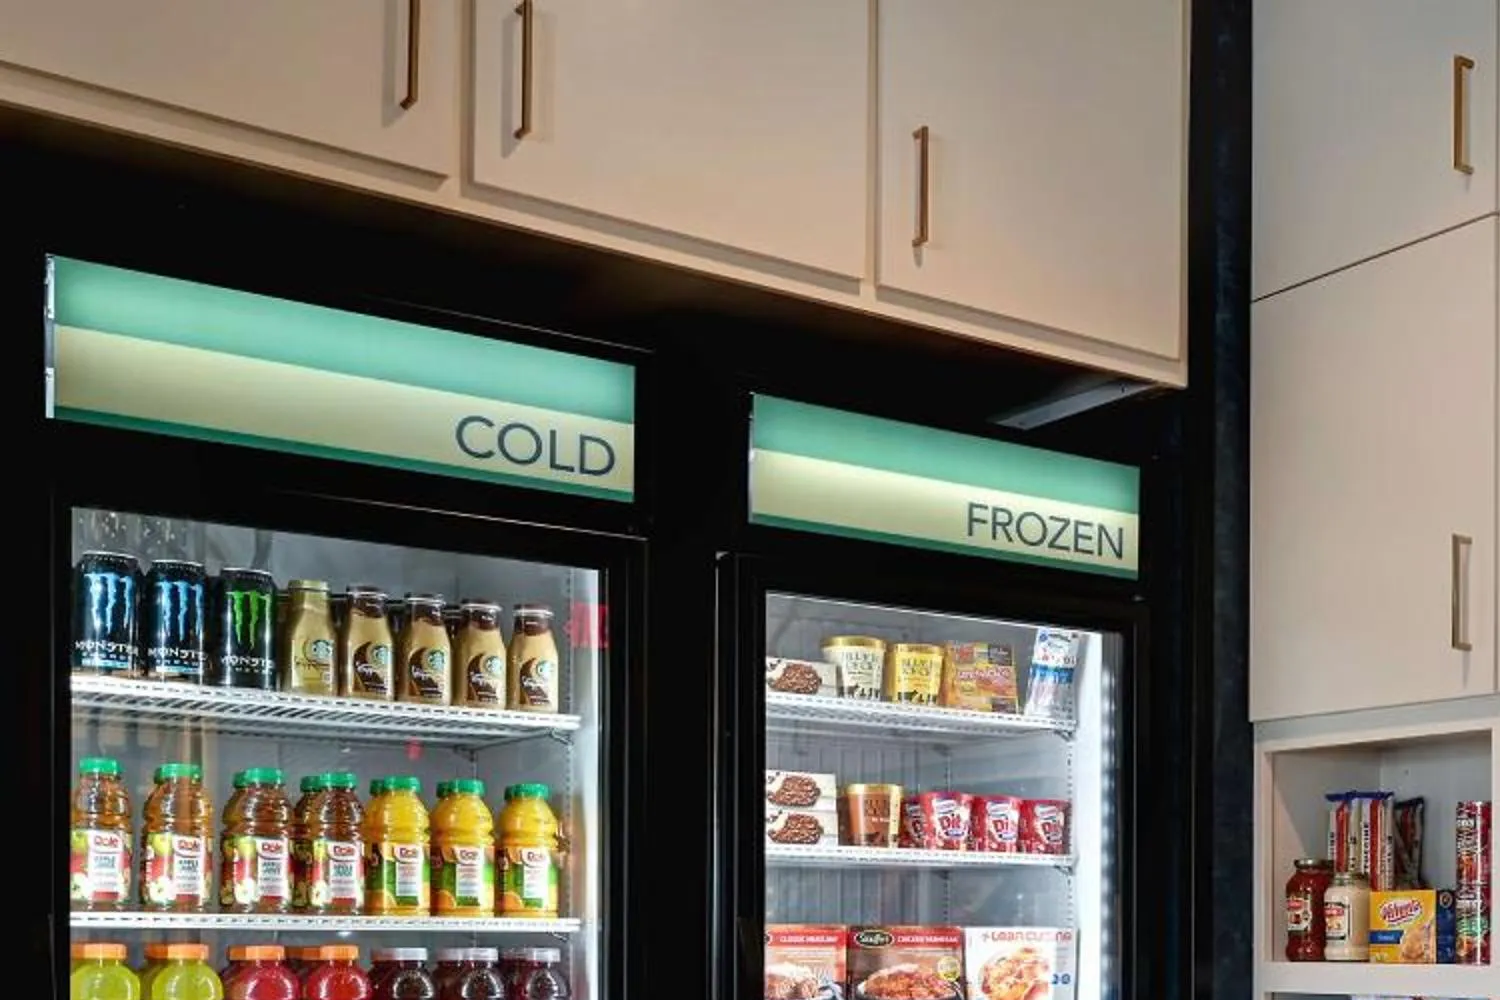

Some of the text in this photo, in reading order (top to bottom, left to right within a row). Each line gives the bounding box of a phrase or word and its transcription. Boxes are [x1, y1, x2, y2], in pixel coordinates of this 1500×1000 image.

[456, 415, 616, 476] COLD
[968, 502, 1124, 560] FROZEN
[221, 655, 275, 669] MONSTE
